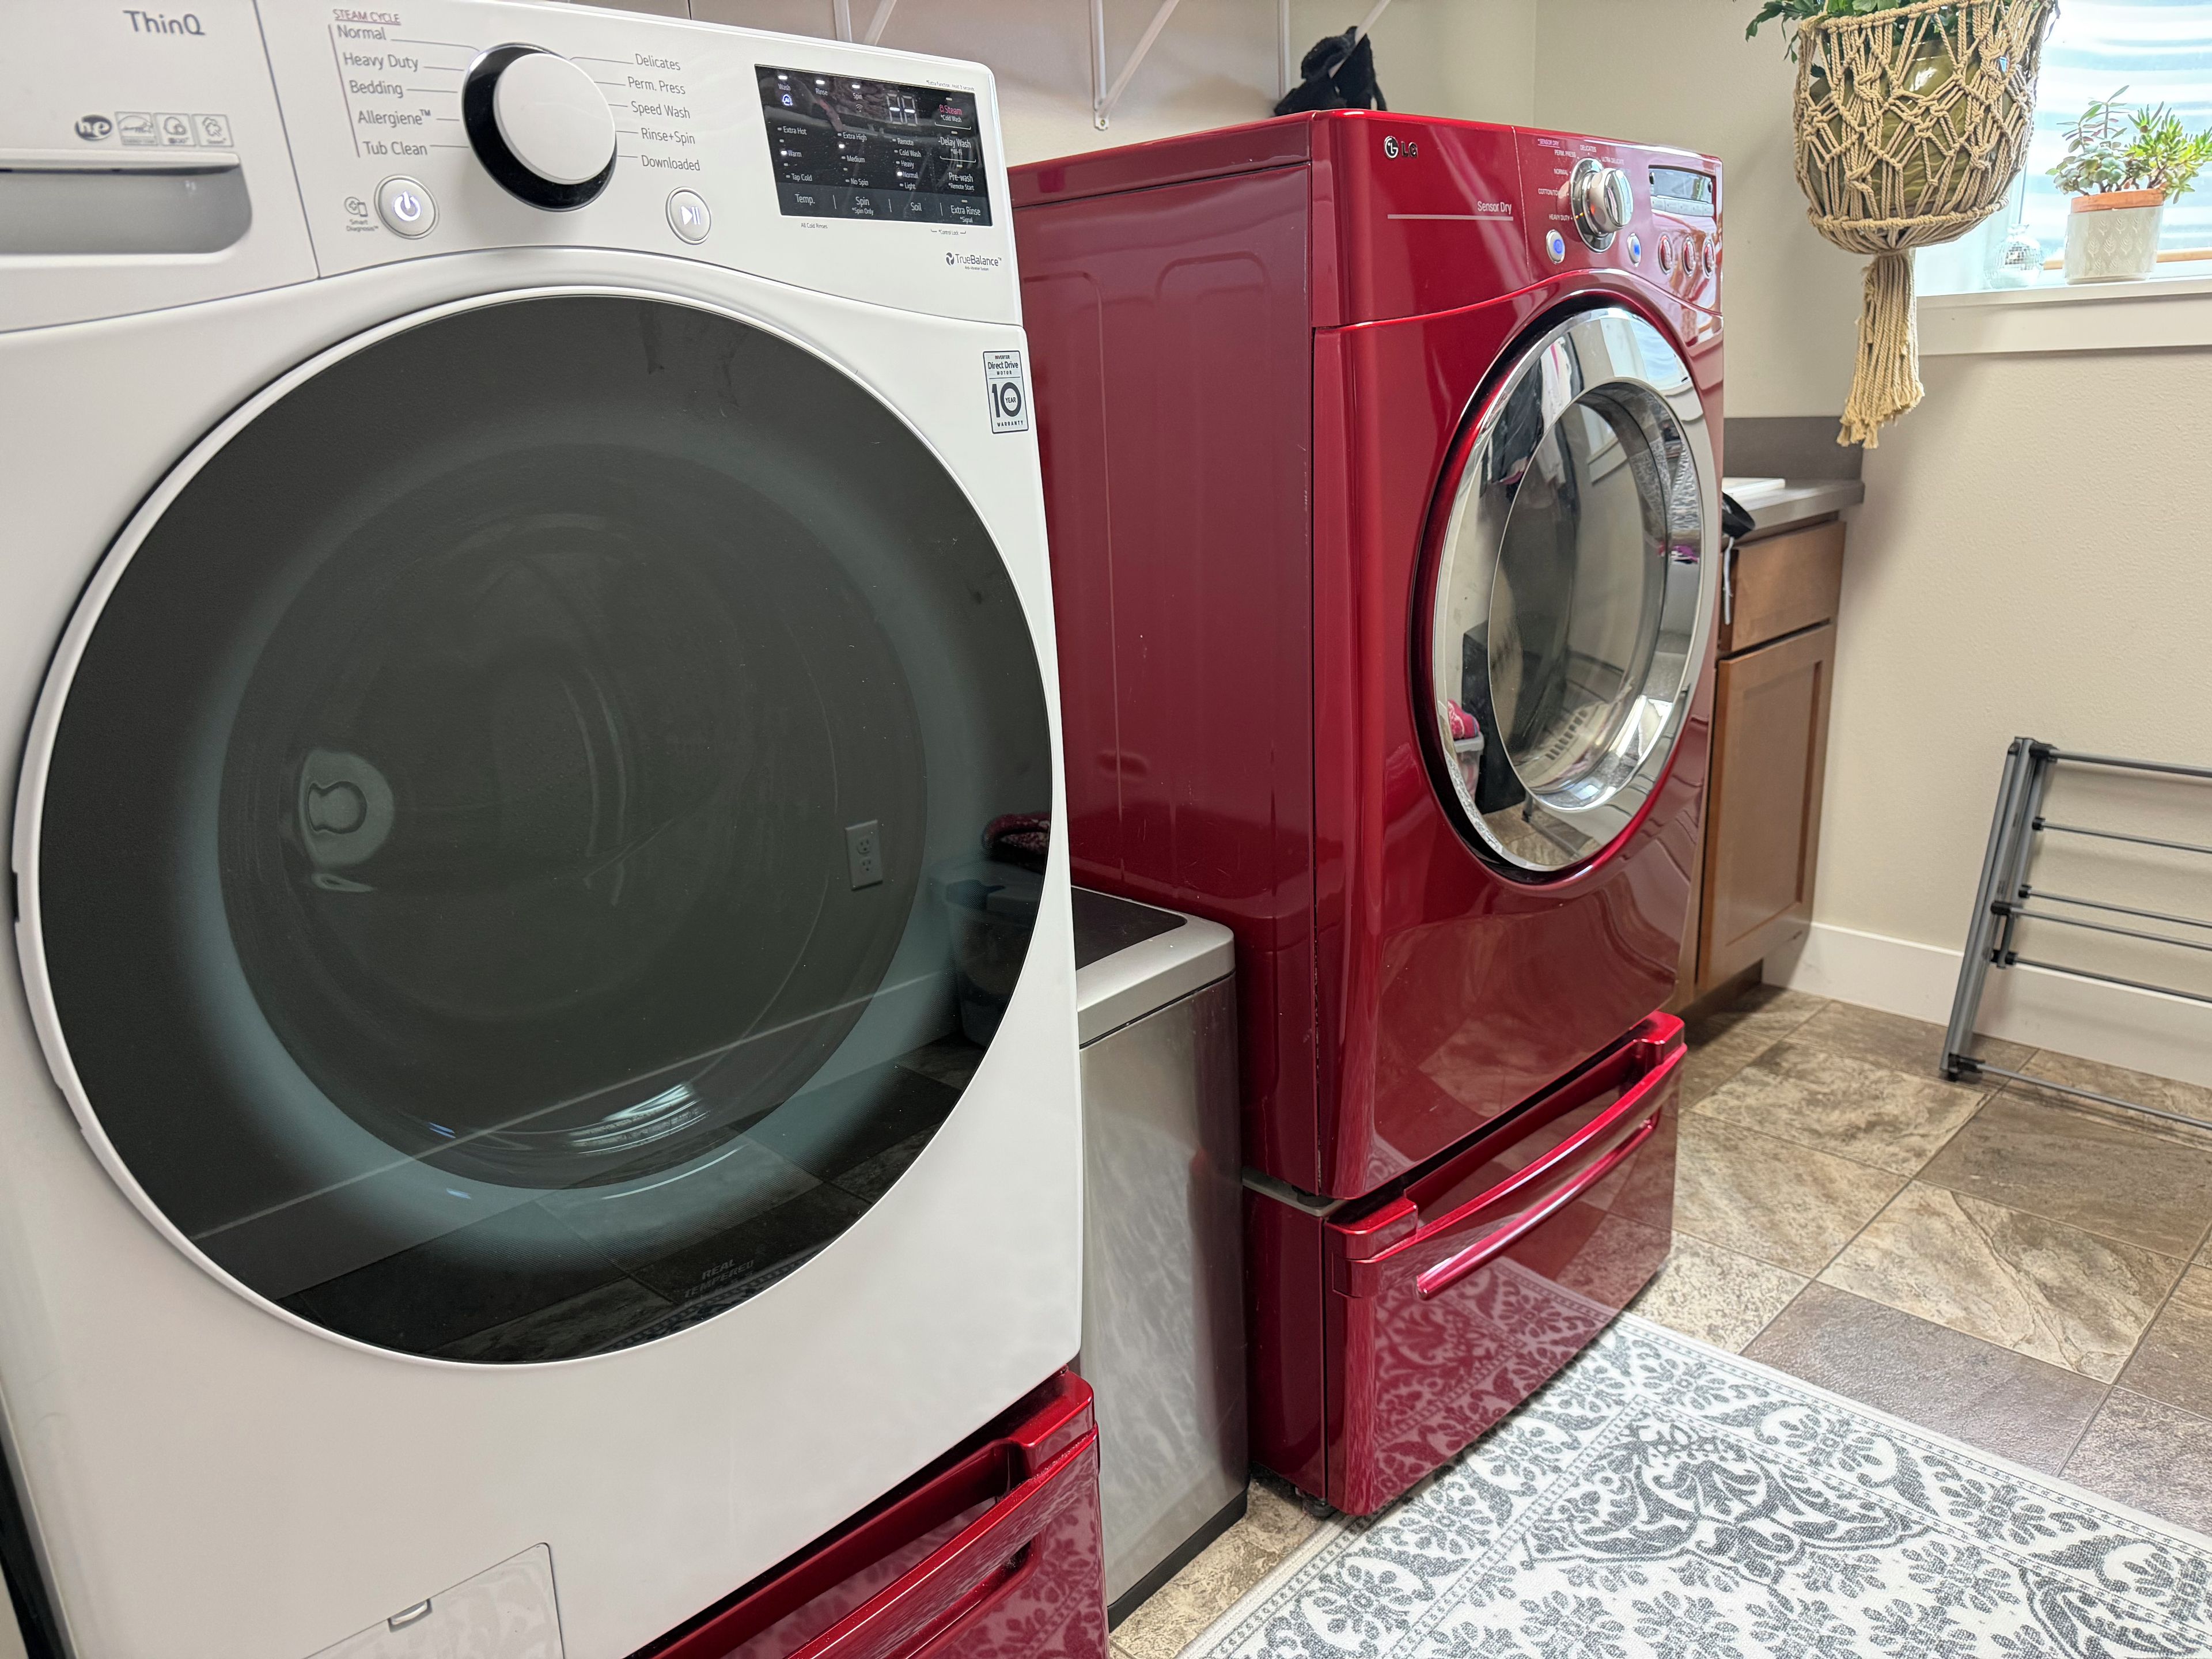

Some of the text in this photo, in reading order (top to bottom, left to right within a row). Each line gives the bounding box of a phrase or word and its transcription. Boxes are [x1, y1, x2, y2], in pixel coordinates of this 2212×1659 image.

[123, 10, 206, 35] ThinQ
[332, 9, 401, 24] STEAM CYCLE
[337, 25, 387, 40] Normal
[343, 52, 418, 72] Heavy Duty
[635, 54, 681, 70] Delicates
[349, 80, 404, 99] Bedding
[628, 76, 685, 94] Perm. Press
[631, 101, 690, 119] Speed Wash
[945, 105, 962, 115] Steam
[641, 127, 695, 146] Rinse+Spin
[797, 127, 807, 135] Hot
[856, 134, 867, 142] High
[956, 140, 971, 149] Wash
[363, 141, 427, 155] Tub Clean
[1401, 141, 1418, 158] LG
[641, 155, 700, 171] Downloaded
[901, 160, 914, 169] Heavy
[791, 173, 800, 181] Tap
[859, 179, 869, 187] Spin
[949, 172, 974, 183] Pre-wash
[904, 182, 916, 191] Light
[795, 194, 815, 206] Temp.
[855, 196, 870, 207] Spin
[911, 202, 922, 211] Soil
[950, 205, 980, 215] Extra Rinse
[1478, 201, 1512, 214] Sensor Dry
[992, 382, 1022, 418] 10
[702, 1259, 736, 1280] REAL
